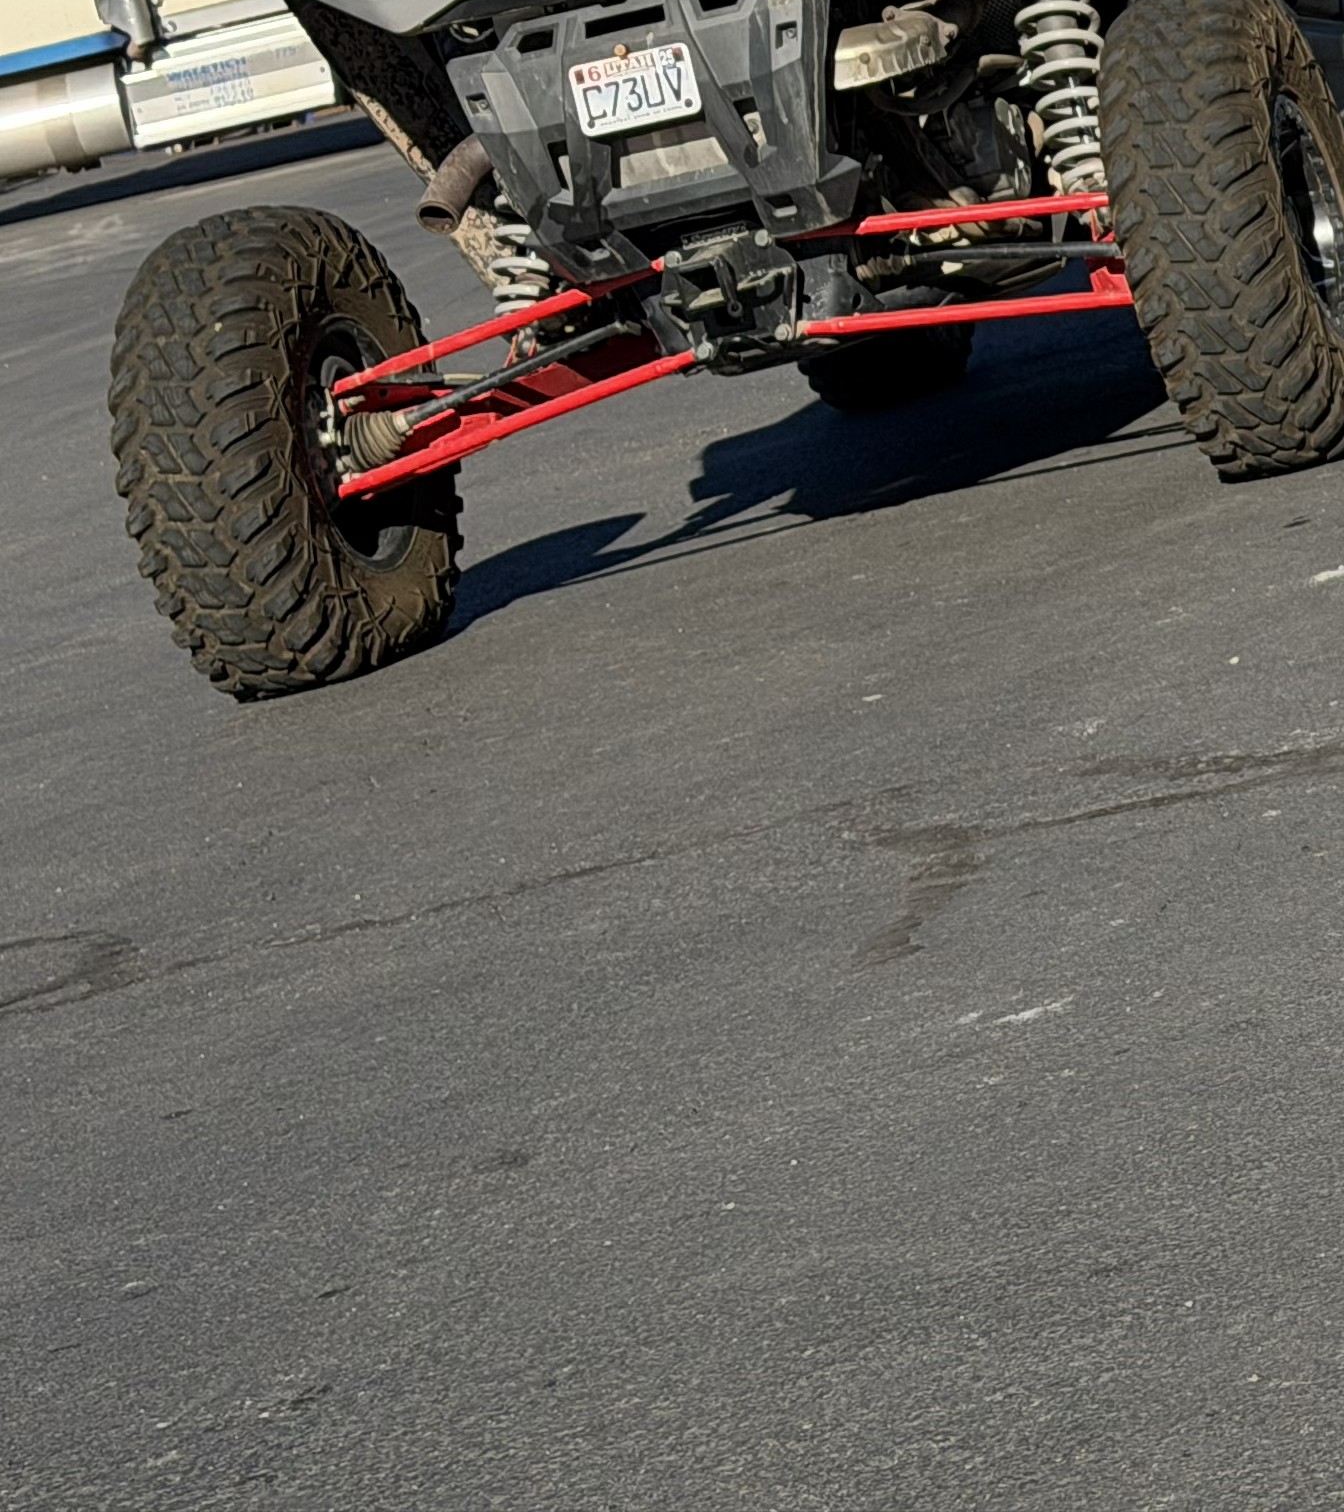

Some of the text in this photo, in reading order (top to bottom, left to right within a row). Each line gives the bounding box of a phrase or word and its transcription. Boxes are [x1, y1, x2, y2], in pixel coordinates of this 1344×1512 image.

[605, 52, 655, 75] UTAH
[659, 48, 676, 67] 25
[588, 65, 602, 82] 6
[582, 66, 682, 120] C73UV
